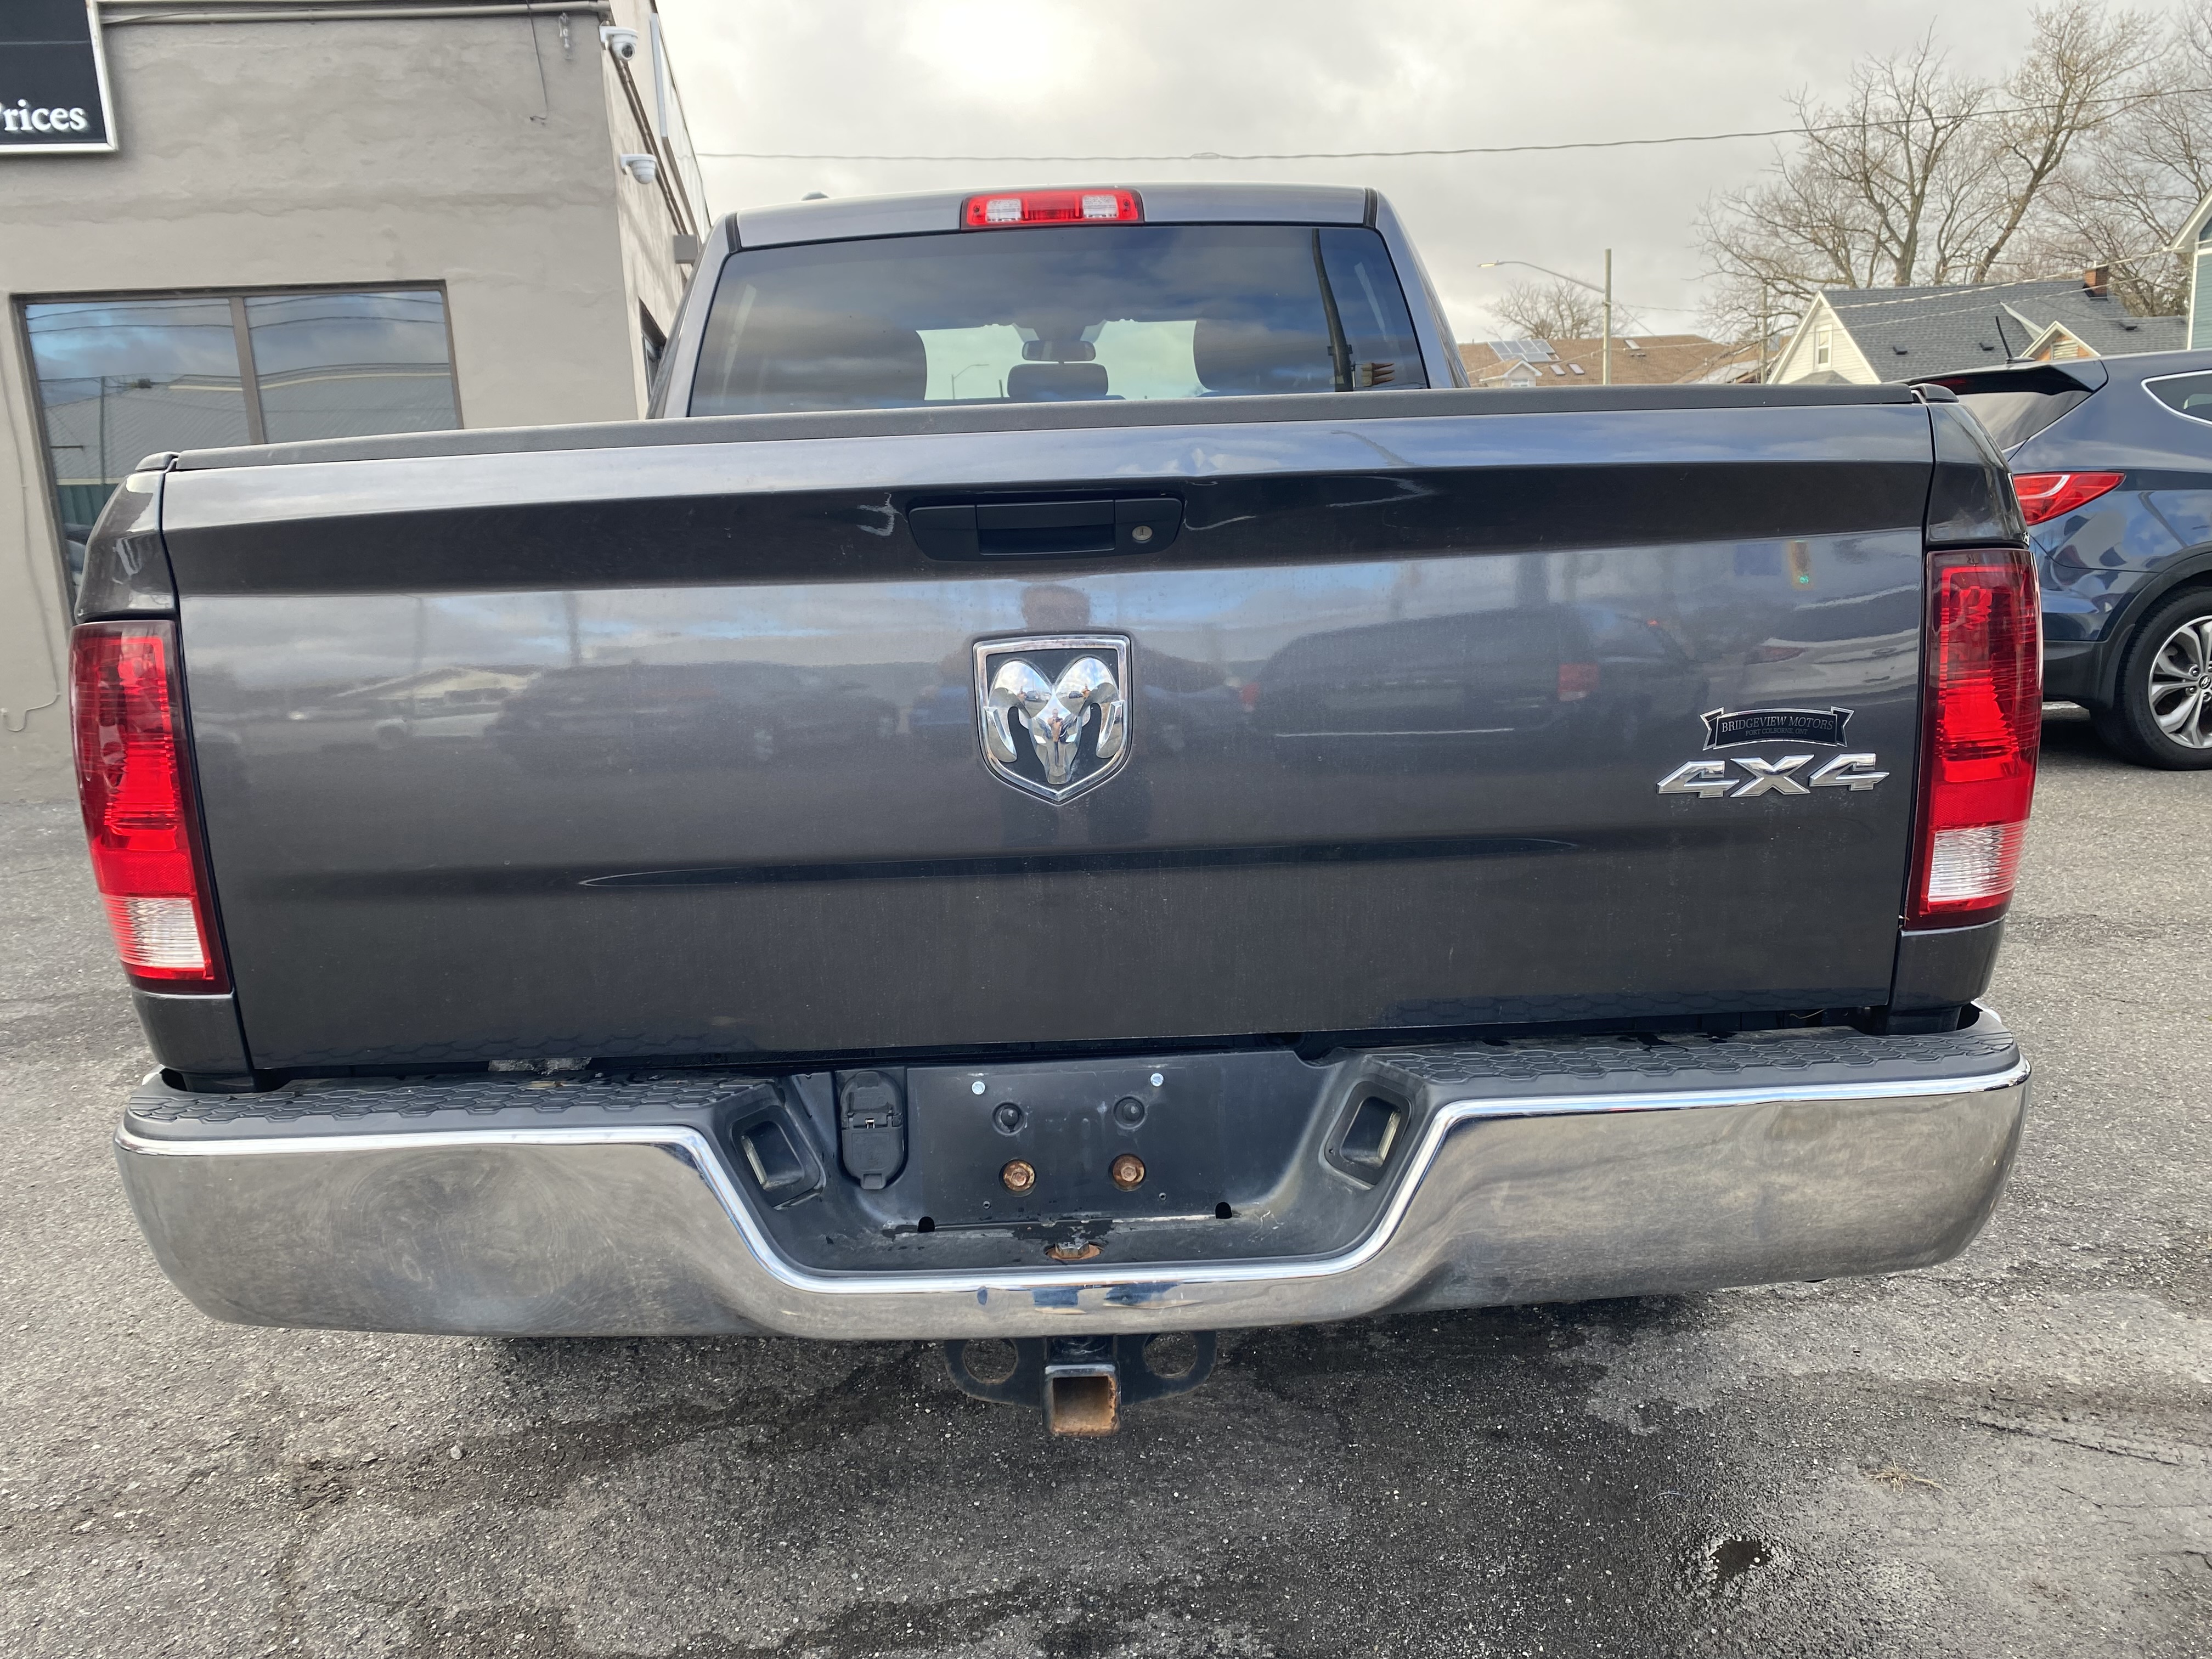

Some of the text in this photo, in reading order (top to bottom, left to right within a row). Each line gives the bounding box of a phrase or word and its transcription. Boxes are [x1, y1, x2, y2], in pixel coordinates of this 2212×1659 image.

[0, 99, 88, 131] rices
[1721, 716, 1834, 732] BRIDGEVIEW MOTORS
[1745, 728, 1761, 736] PORT
[1657, 753, 1890, 798] 4X4
